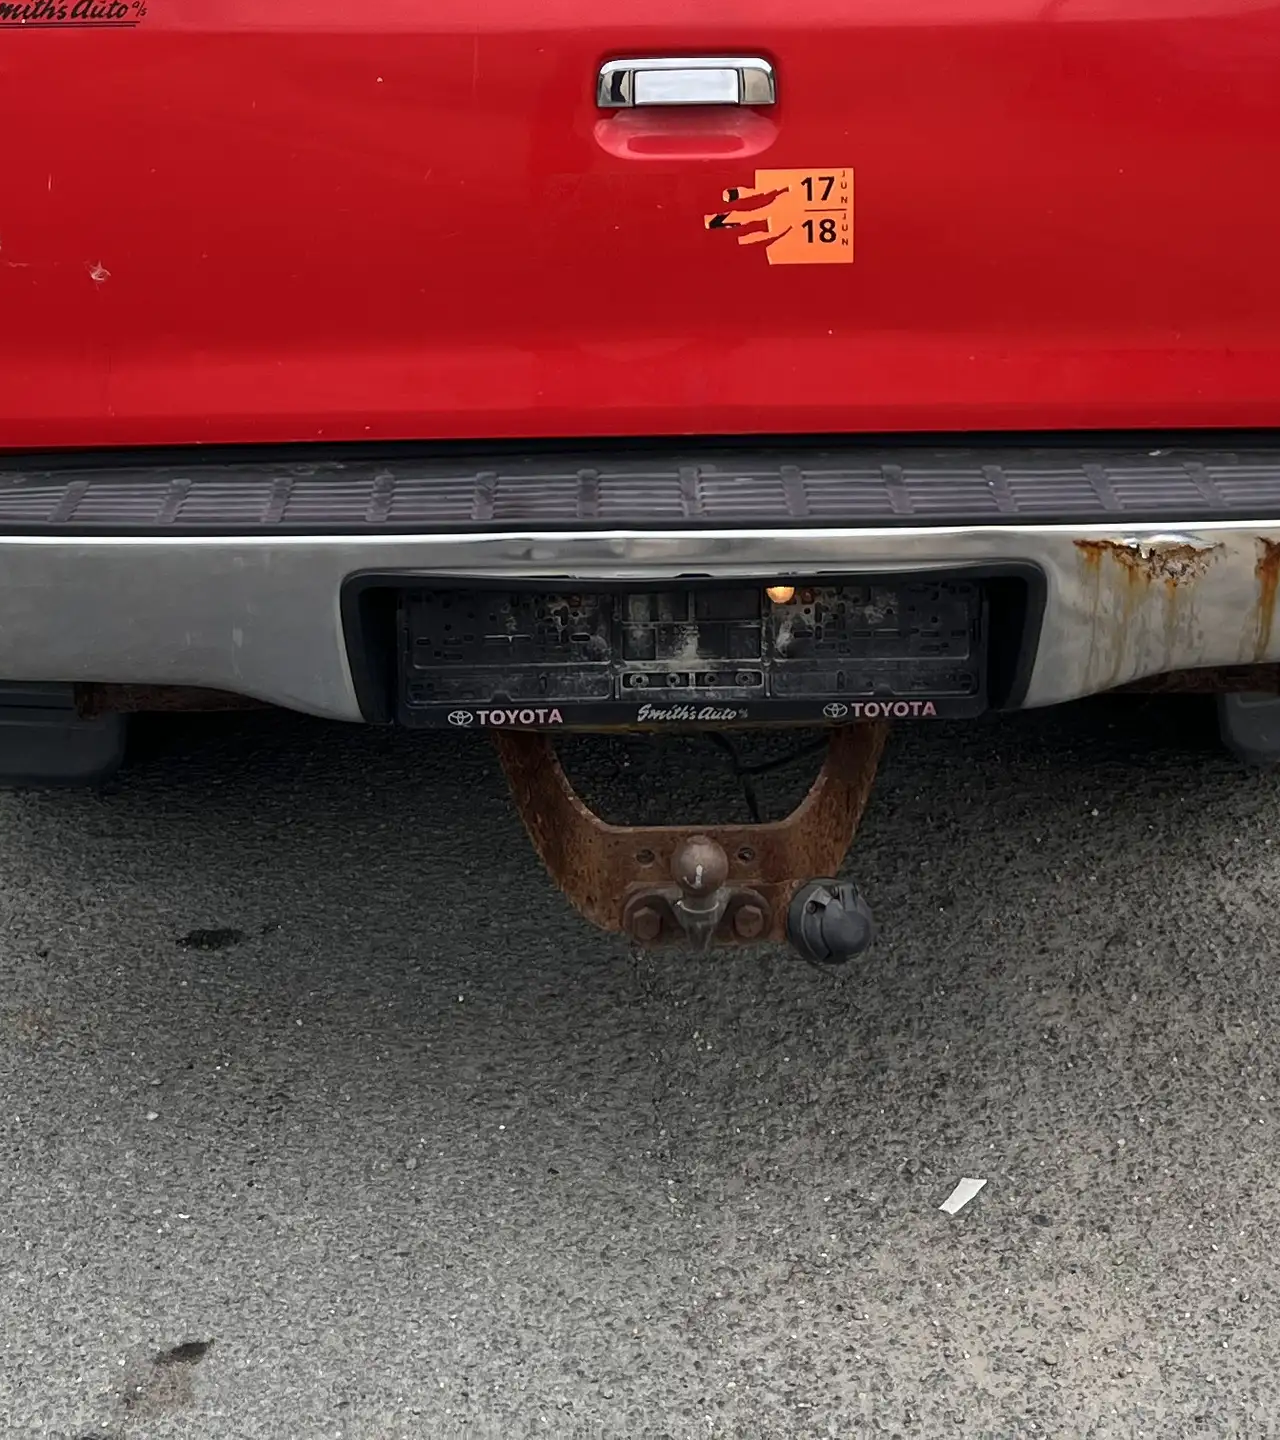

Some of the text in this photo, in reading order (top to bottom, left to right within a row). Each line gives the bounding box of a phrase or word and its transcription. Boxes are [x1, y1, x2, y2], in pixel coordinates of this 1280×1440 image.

[801, 176, 835, 201] 17
[840, 170, 848, 204] JUN
[801, 219, 837, 243] 18
[841, 213, 849, 246] JUN
[476, 708, 563, 725] TOYOTA
[637, 703, 697, 722] Smith's
[698, 706, 737, 720] Auto
[851, 701, 937, 717] TOYOTA
